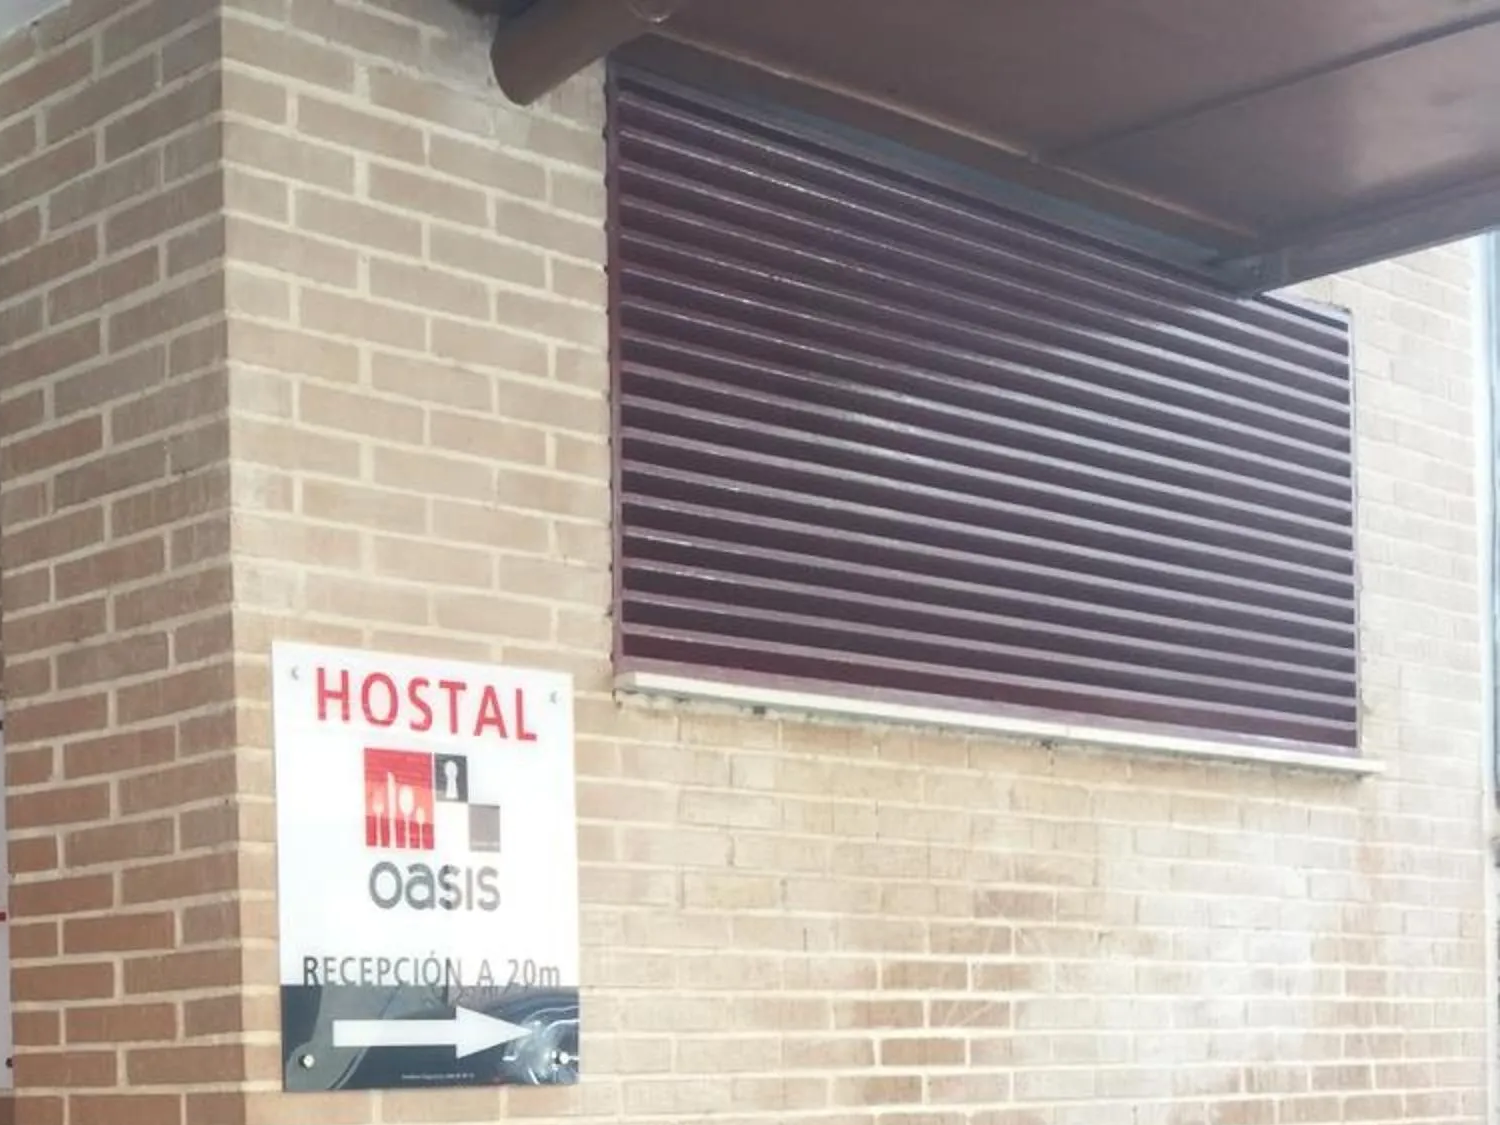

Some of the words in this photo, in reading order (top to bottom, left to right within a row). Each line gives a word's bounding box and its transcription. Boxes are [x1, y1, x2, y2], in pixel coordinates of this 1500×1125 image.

[315, 666, 538, 742] HOSTAL
[368, 860, 501, 912] oasis
[302, 951, 462, 988] RECEPCIÓN
[477, 957, 495, 988] A
[508, 957, 561, 988] 20m
